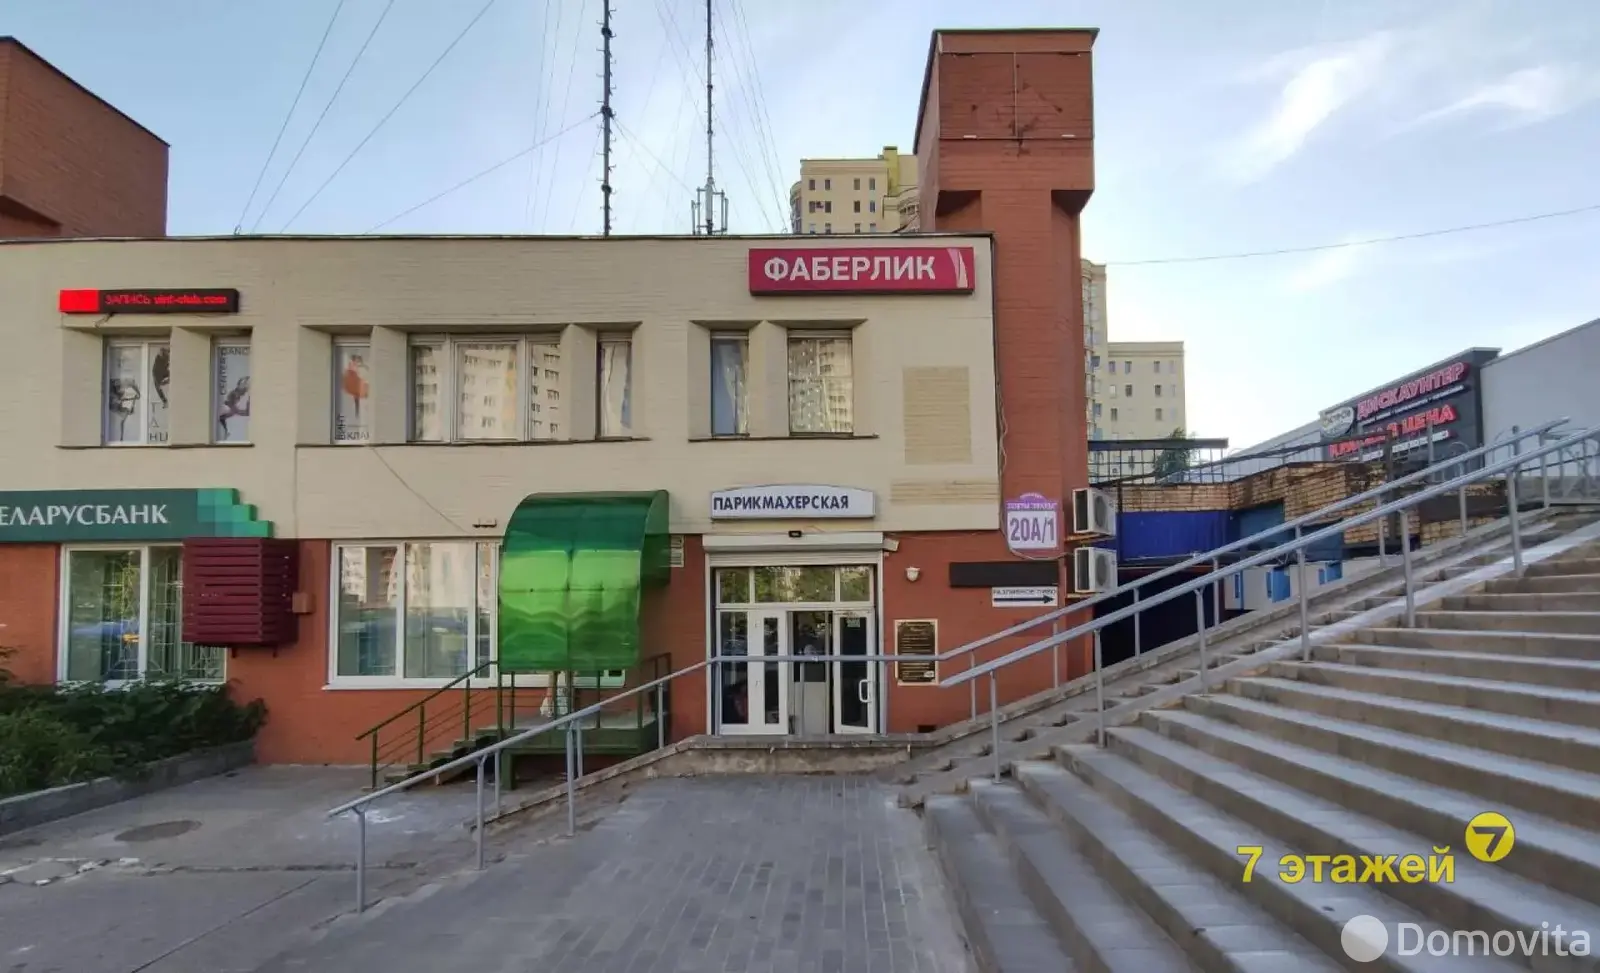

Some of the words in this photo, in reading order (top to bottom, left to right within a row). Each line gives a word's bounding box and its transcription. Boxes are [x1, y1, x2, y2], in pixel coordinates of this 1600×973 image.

[764, 255, 936, 281] ФАБЕРЛИК
[1357, 362, 1465, 420] ДИСКАУНТЕР
[1401, 404, 1456, 435] ЦЕНА
[0, 504, 168, 526] ЕЛАРУСБАНК
[713, 495, 849, 511] ПАРИКМАХЕРСКАЯ
[1010, 517, 1055, 543] 20А/1
